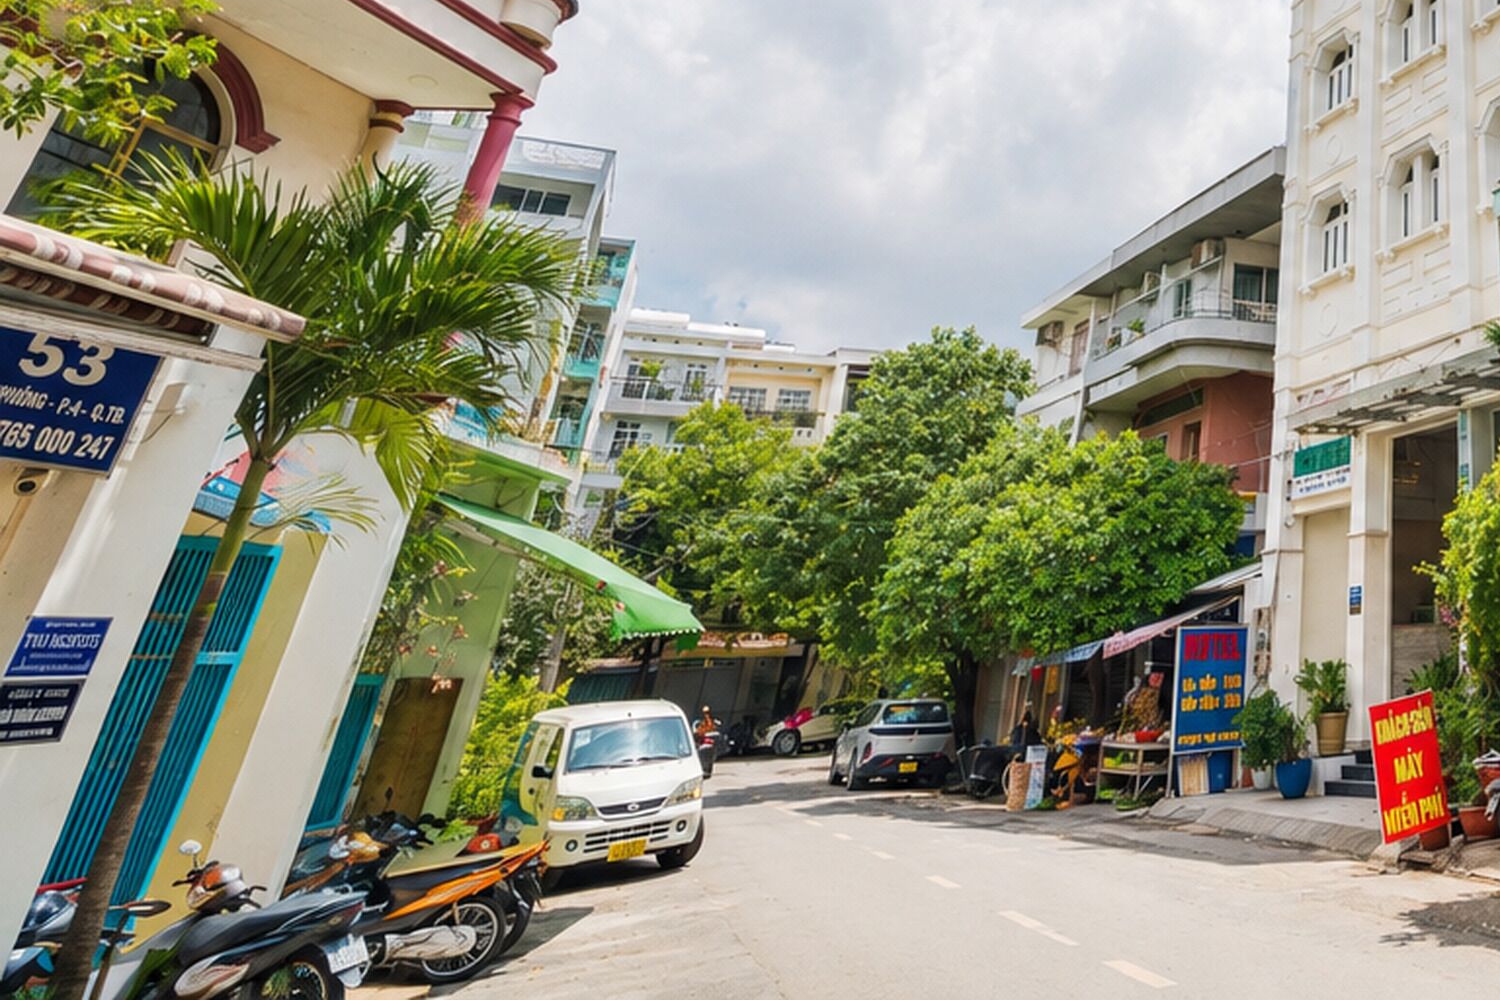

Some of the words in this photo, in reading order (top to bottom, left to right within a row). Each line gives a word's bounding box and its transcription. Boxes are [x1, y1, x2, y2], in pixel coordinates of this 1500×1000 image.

[18, 332, 115, 386] 53
[34, 426, 75, 455] 000
[74, 434, 115, 460] 247
